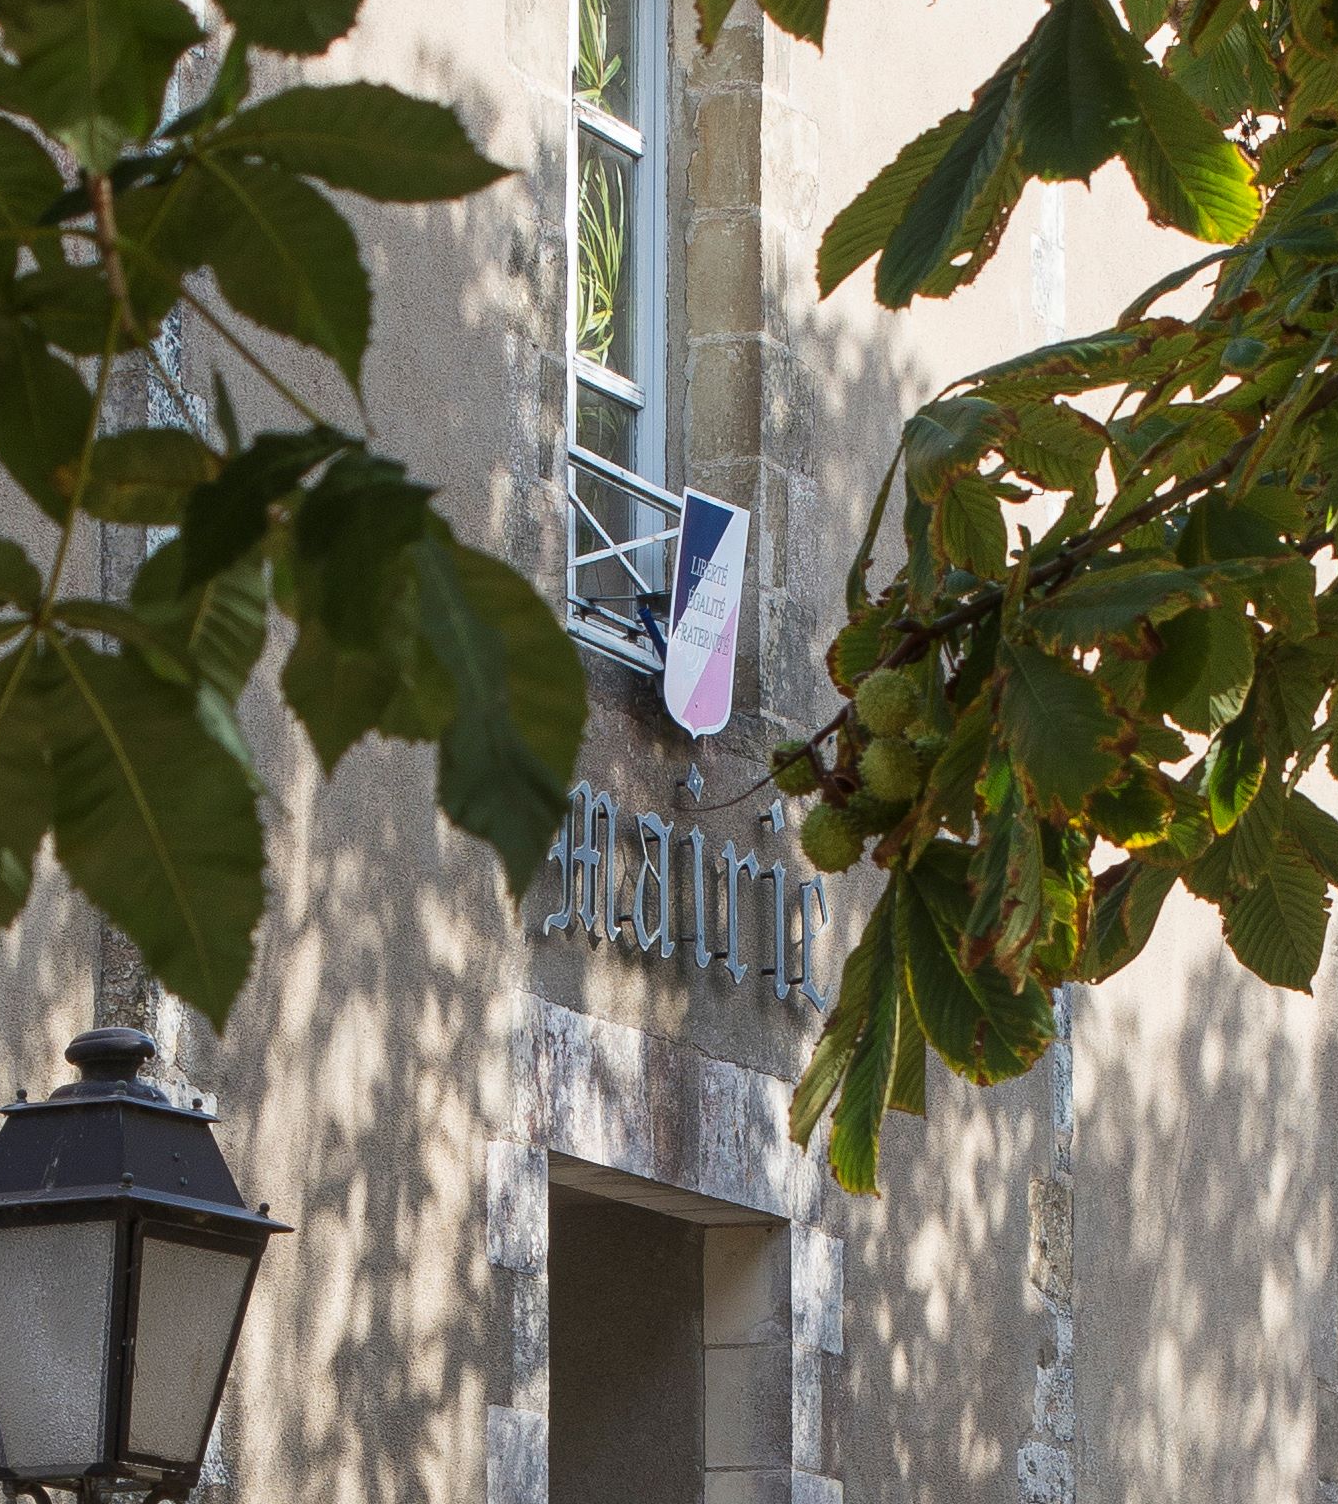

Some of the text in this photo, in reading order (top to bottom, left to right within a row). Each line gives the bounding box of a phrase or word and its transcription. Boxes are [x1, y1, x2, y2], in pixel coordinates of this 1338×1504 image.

[691, 556, 728, 587] LIBERTÉ
[687, 585, 725, 620] ÉGALITÉ
[675, 620, 731, 656] FRATERNITÉ
[543, 763, 831, 1012] Mairie
